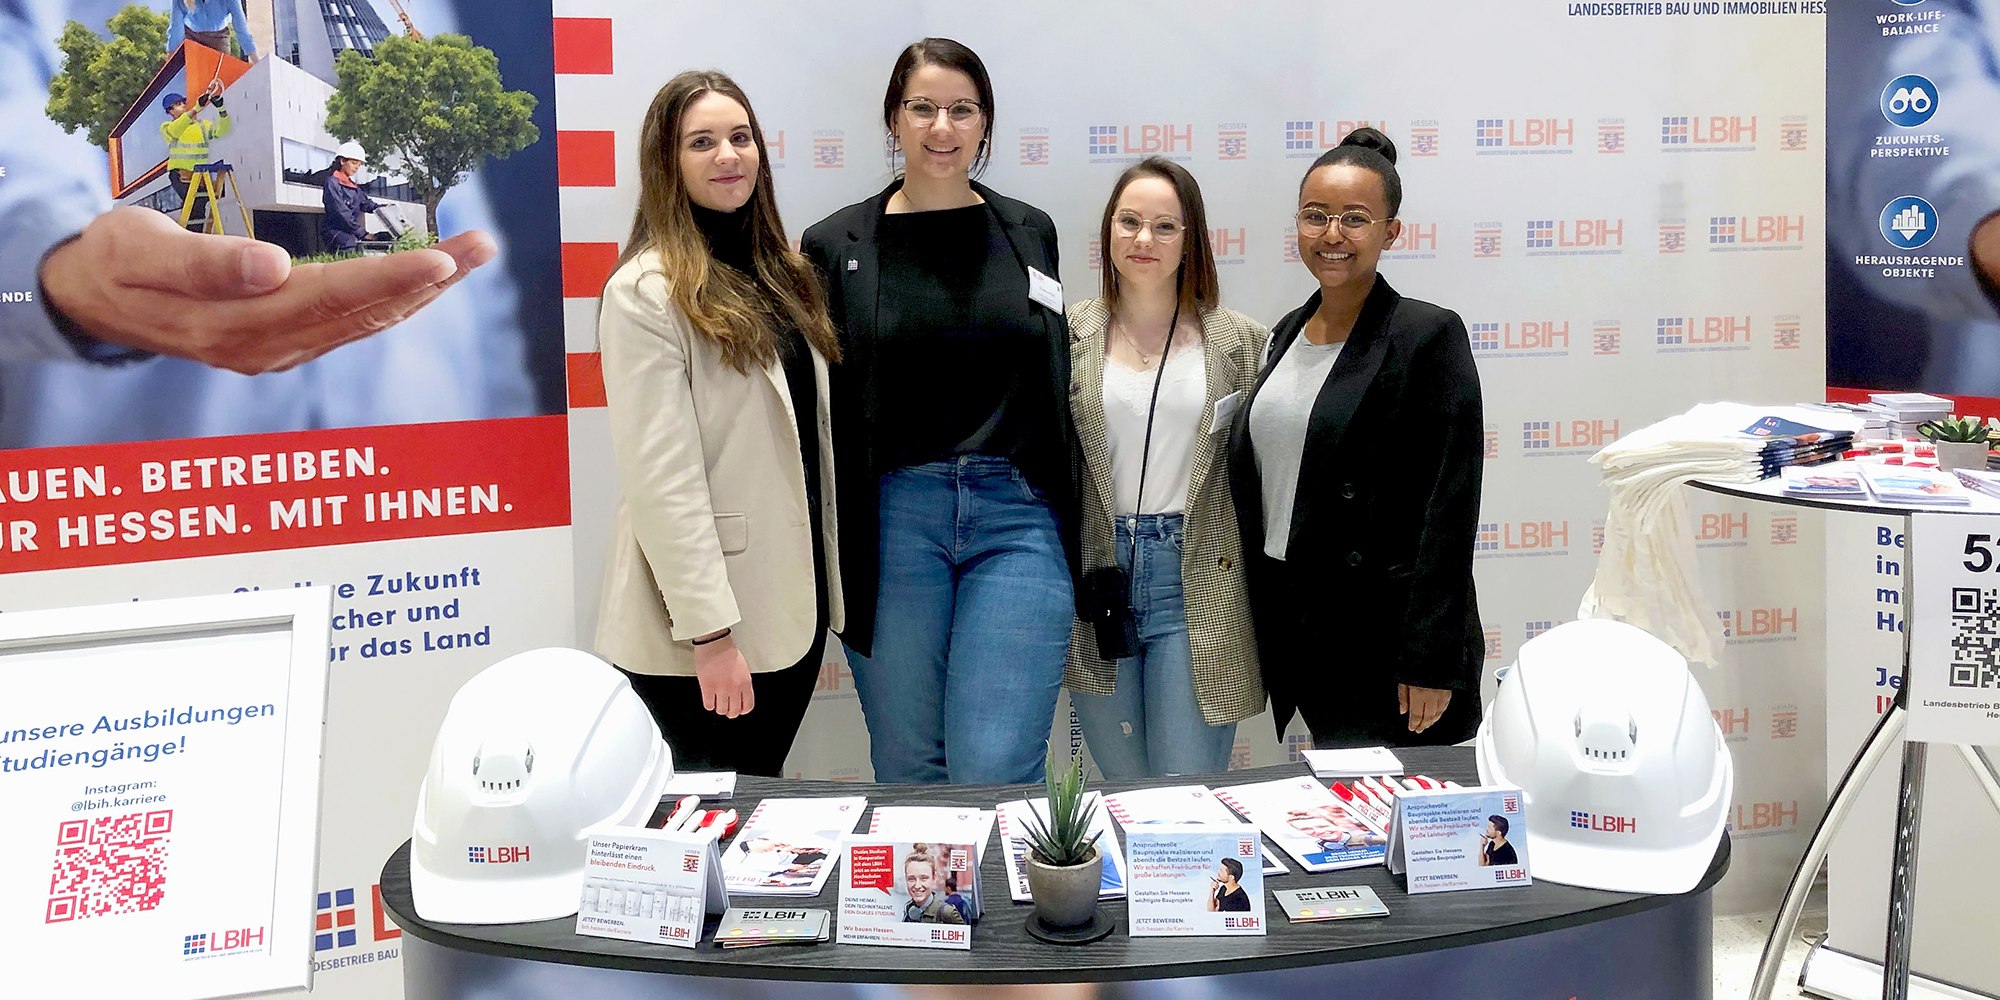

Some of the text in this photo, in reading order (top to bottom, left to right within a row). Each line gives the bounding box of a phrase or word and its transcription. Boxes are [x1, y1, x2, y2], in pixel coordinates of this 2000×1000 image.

[1568, 3, 1662, 16] LANDESBETRIEB
[1666, 2, 1689, 15] BAU
[1694, 2, 1719, 15] UND
[1724, 1, 1796, 15] IMMOBILIEN
[1876, 11, 1945, 25] WORK-LIFE-
[1882, 24, 1939, 36] BALANCE
[1217, 122, 1247, 130] HESSEN
[1409, 119, 1438, 127] HESSEN
[1692, 116, 1757, 144] LBIH
[1123, 124, 1192, 153] LBIH
[1508, 119, 1574, 146] LBIH
[1875, 134, 1944, 146] ZUKUNFTS-
[1870, 146, 1950, 158] PERSPEKTIVE
[1558, 219, 1623, 247] LBIH
[1741, 216, 1804, 242] LBIH
[1855, 255, 1964, 266] HERAUSRAGENDE
[1882, 268, 1935, 278] OBJEKTE
[0, 291, 33, 303] NDE
[1504, 321, 1569, 349] LBIH
[1688, 316, 1750, 343] LBIH
[1555, 419, 1619, 447] LBIH
[141, 446, 390, 494] BETREIBEN.
[58, 503, 252, 549] HESSEN.
[270, 495, 349, 530] MIT
[364, 483, 513, 523] IHNEN.
[1504, 521, 1568, 549] LBIH
[367, 566, 480, 596] Zukunft
[407, 598, 459, 622] und
[1736, 608, 1797, 636] LBIH
[360, 637, 412, 659] das
[423, 625, 490, 651] Land
[1923, 699, 1990, 710] Landesbetrieb
[92, 703, 275, 734] Ausbildungen
[0, 736, 186, 772] tudiengänge!
[84, 780, 157, 795] Instagram:
[71, 793, 167, 812] @lbih.karriere
[1592, 814, 1636, 833] LBIH
[1737, 801, 1798, 831] LBIH
[592, 840, 648, 852] Unser Papierkram
[487, 846, 530, 865] LBIH
[591, 849, 642, 861] hinterlässt einen
[590, 859, 656, 872] bleibenden Eindruck.
[1505, 869, 1526, 879] LBIH
[1316, 890, 1360, 900] LBIH
[763, 911, 807, 920] LBIH
[1236, 917, 1259, 928] LBIH
[210, 926, 264, 951] LBIH
[669, 926, 690, 939] LBIH
[942, 929, 965, 941] LBIH
[377, 948, 399, 961] BAU
